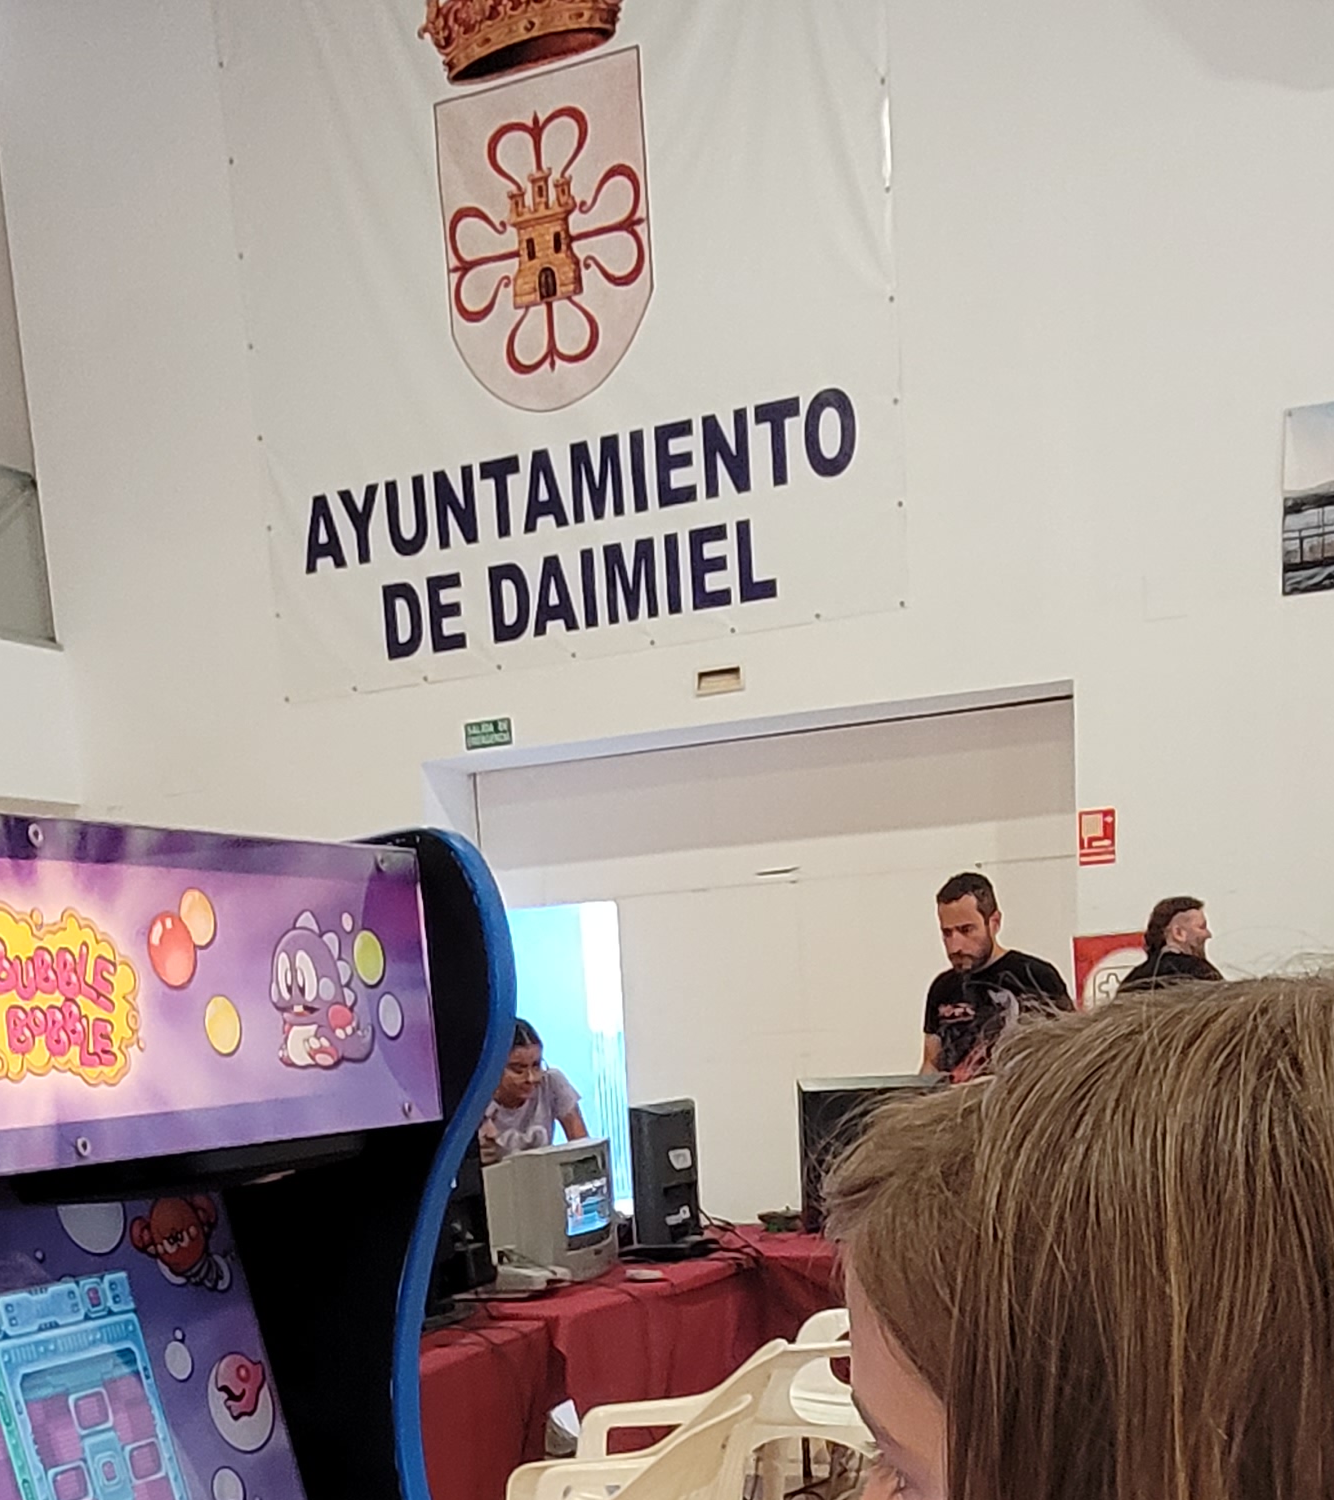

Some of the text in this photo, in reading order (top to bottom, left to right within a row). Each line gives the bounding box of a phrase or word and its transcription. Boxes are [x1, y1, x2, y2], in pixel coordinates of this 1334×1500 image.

[306, 388, 856, 573] AYUNTAMIENTO
[381, 520, 777, 660] DE DAIMIEL
[6, 998, 117, 1067] BOBBLE
